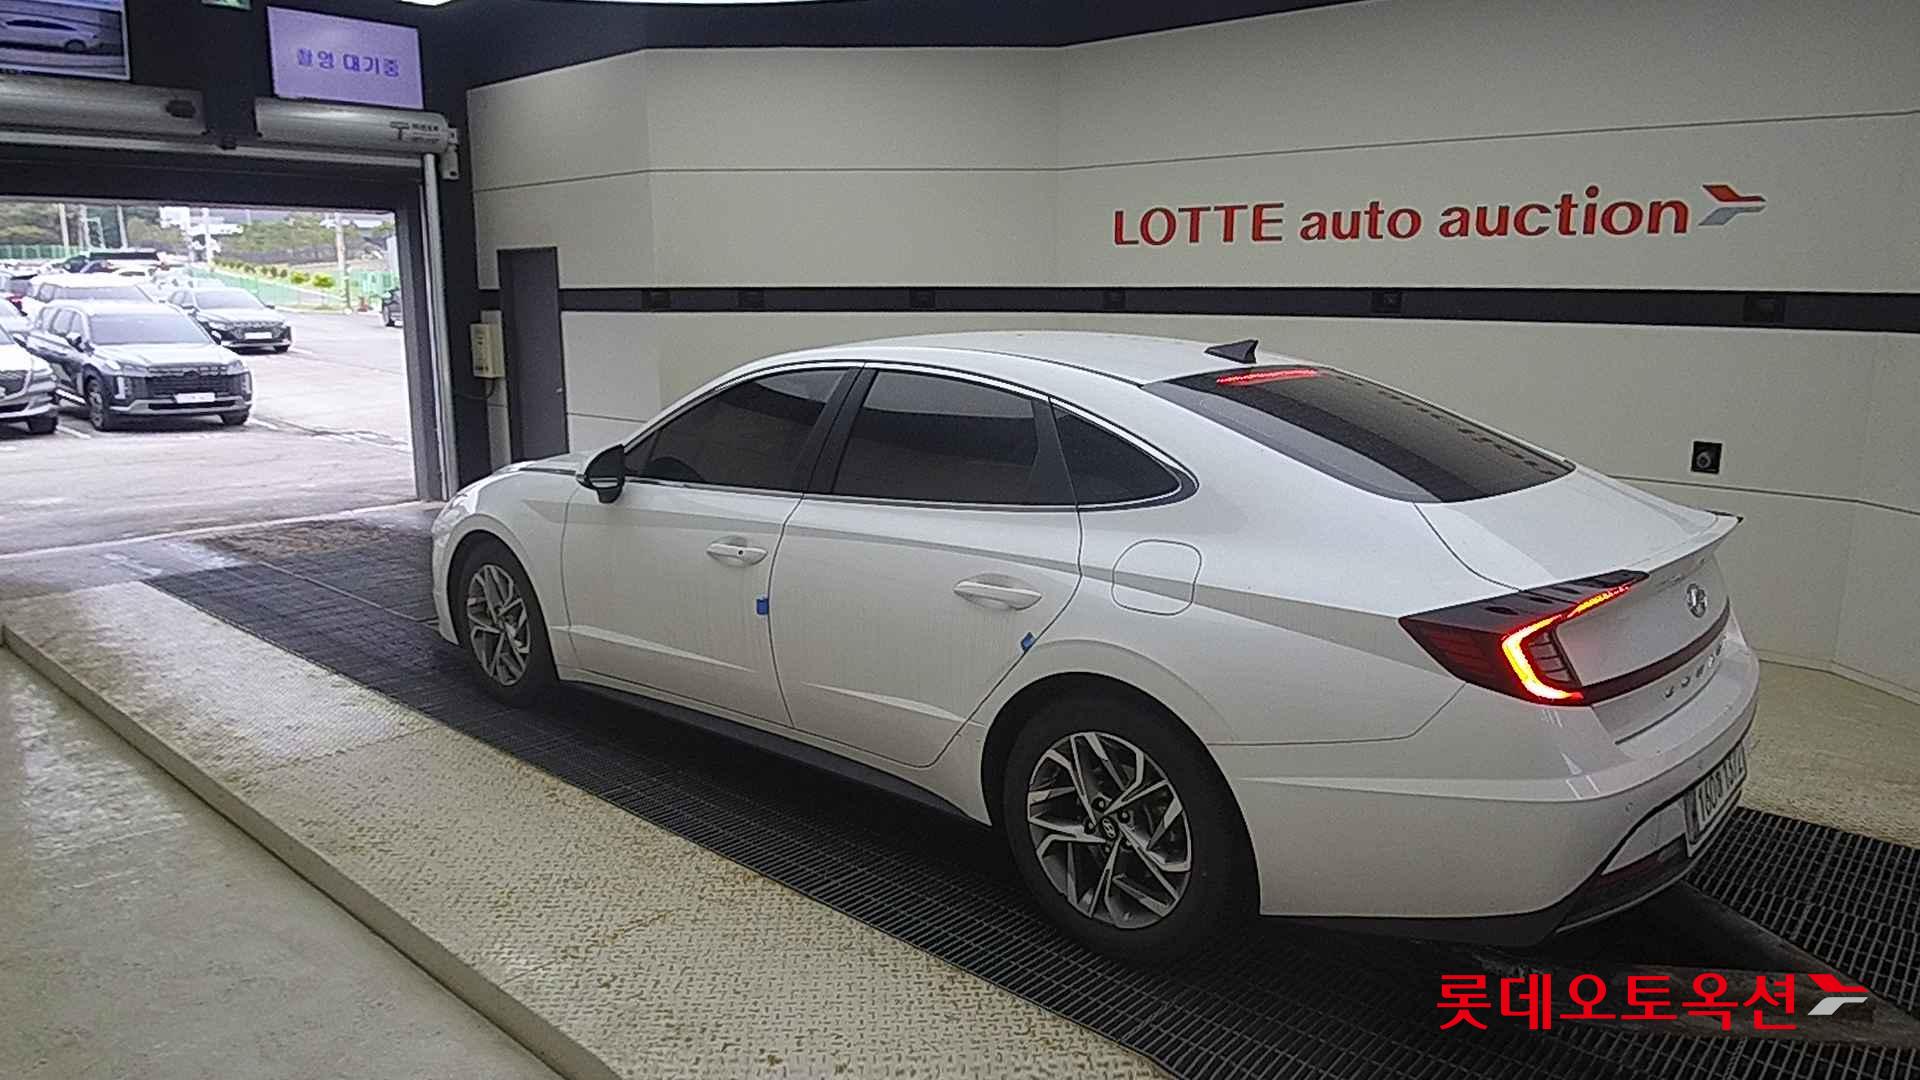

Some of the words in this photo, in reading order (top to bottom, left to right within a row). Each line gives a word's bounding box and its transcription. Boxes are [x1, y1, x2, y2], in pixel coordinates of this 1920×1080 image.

[343, 53, 400, 77] 대기중
[1113, 202, 1284, 246] LOTTE
[1299, 200, 1422, 241] auto
[1439, 185, 1689, 237] auction
